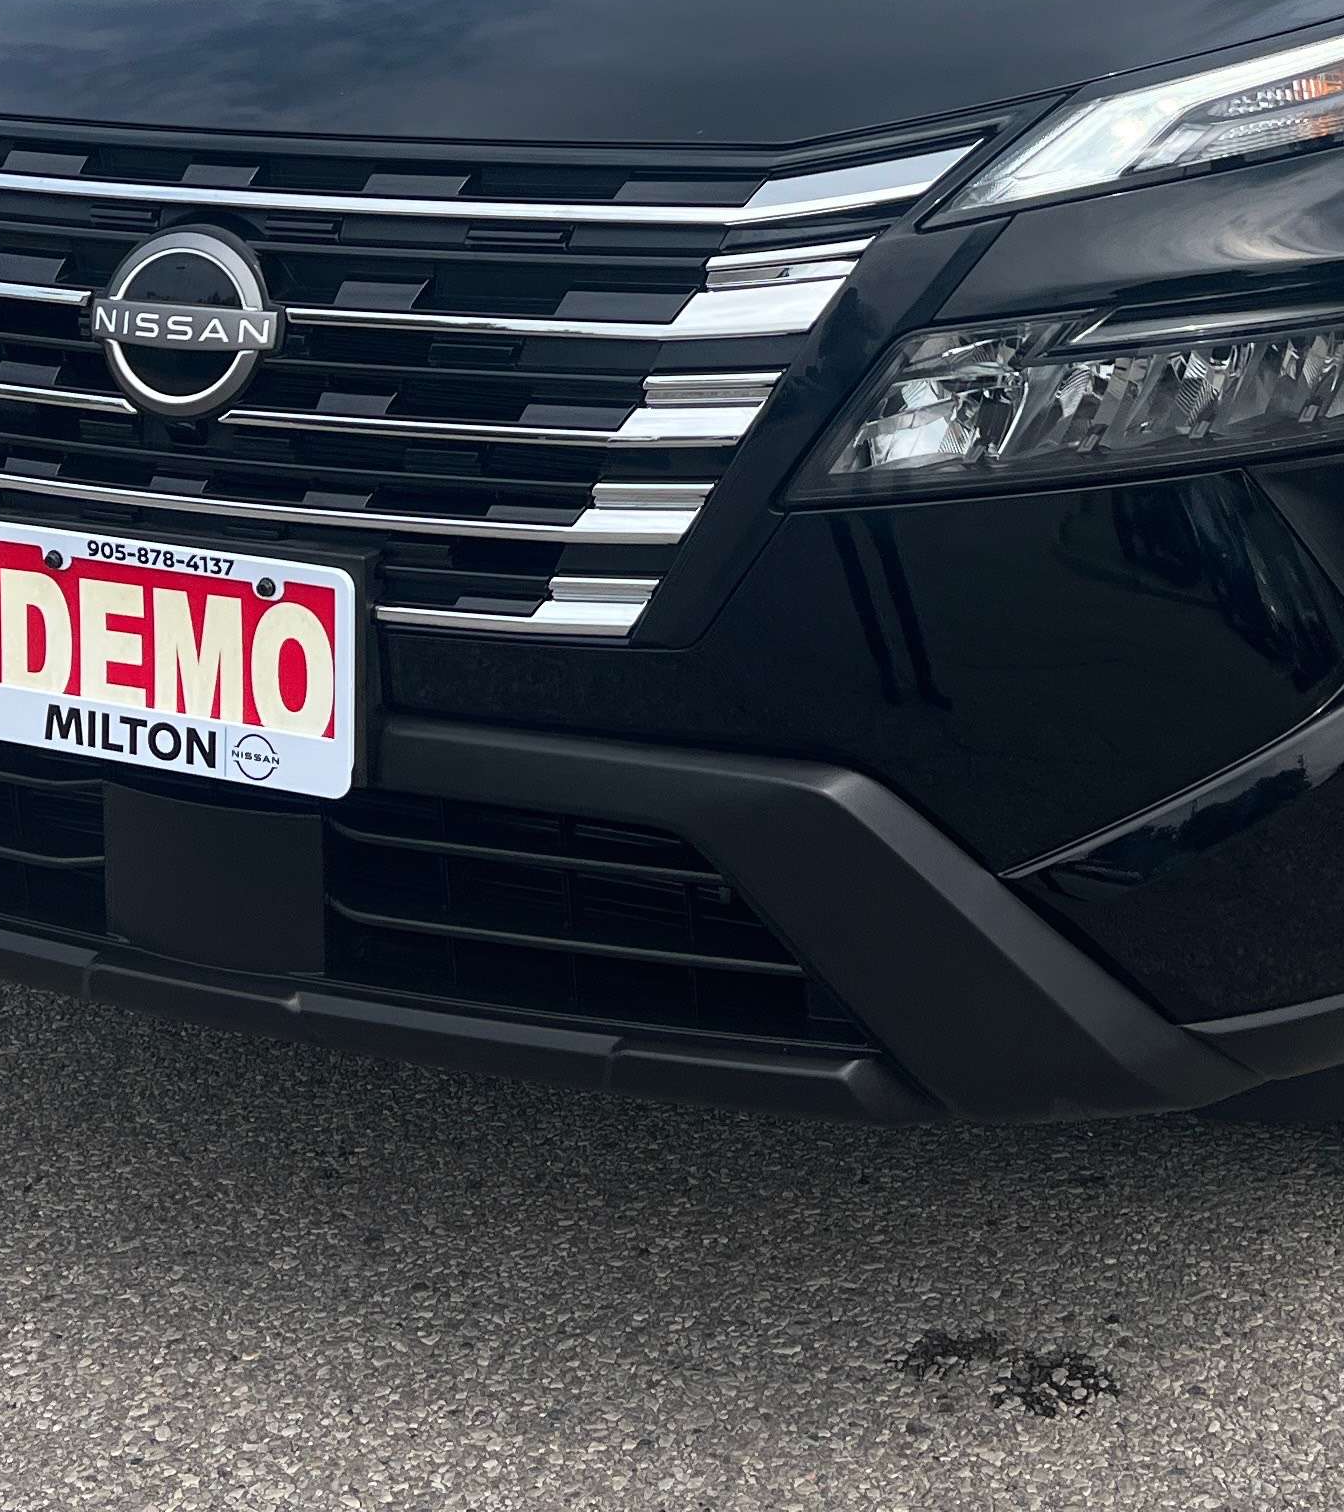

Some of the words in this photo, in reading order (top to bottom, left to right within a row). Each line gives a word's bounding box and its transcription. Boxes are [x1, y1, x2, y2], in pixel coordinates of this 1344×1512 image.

[95, 306, 270, 344] NISSAN
[87, 540, 234, 576] 905-878-4137
[0, 568, 335, 738] DEMO
[44, 703, 217, 769] MILTON
[231, 749, 281, 766] NISSAN
